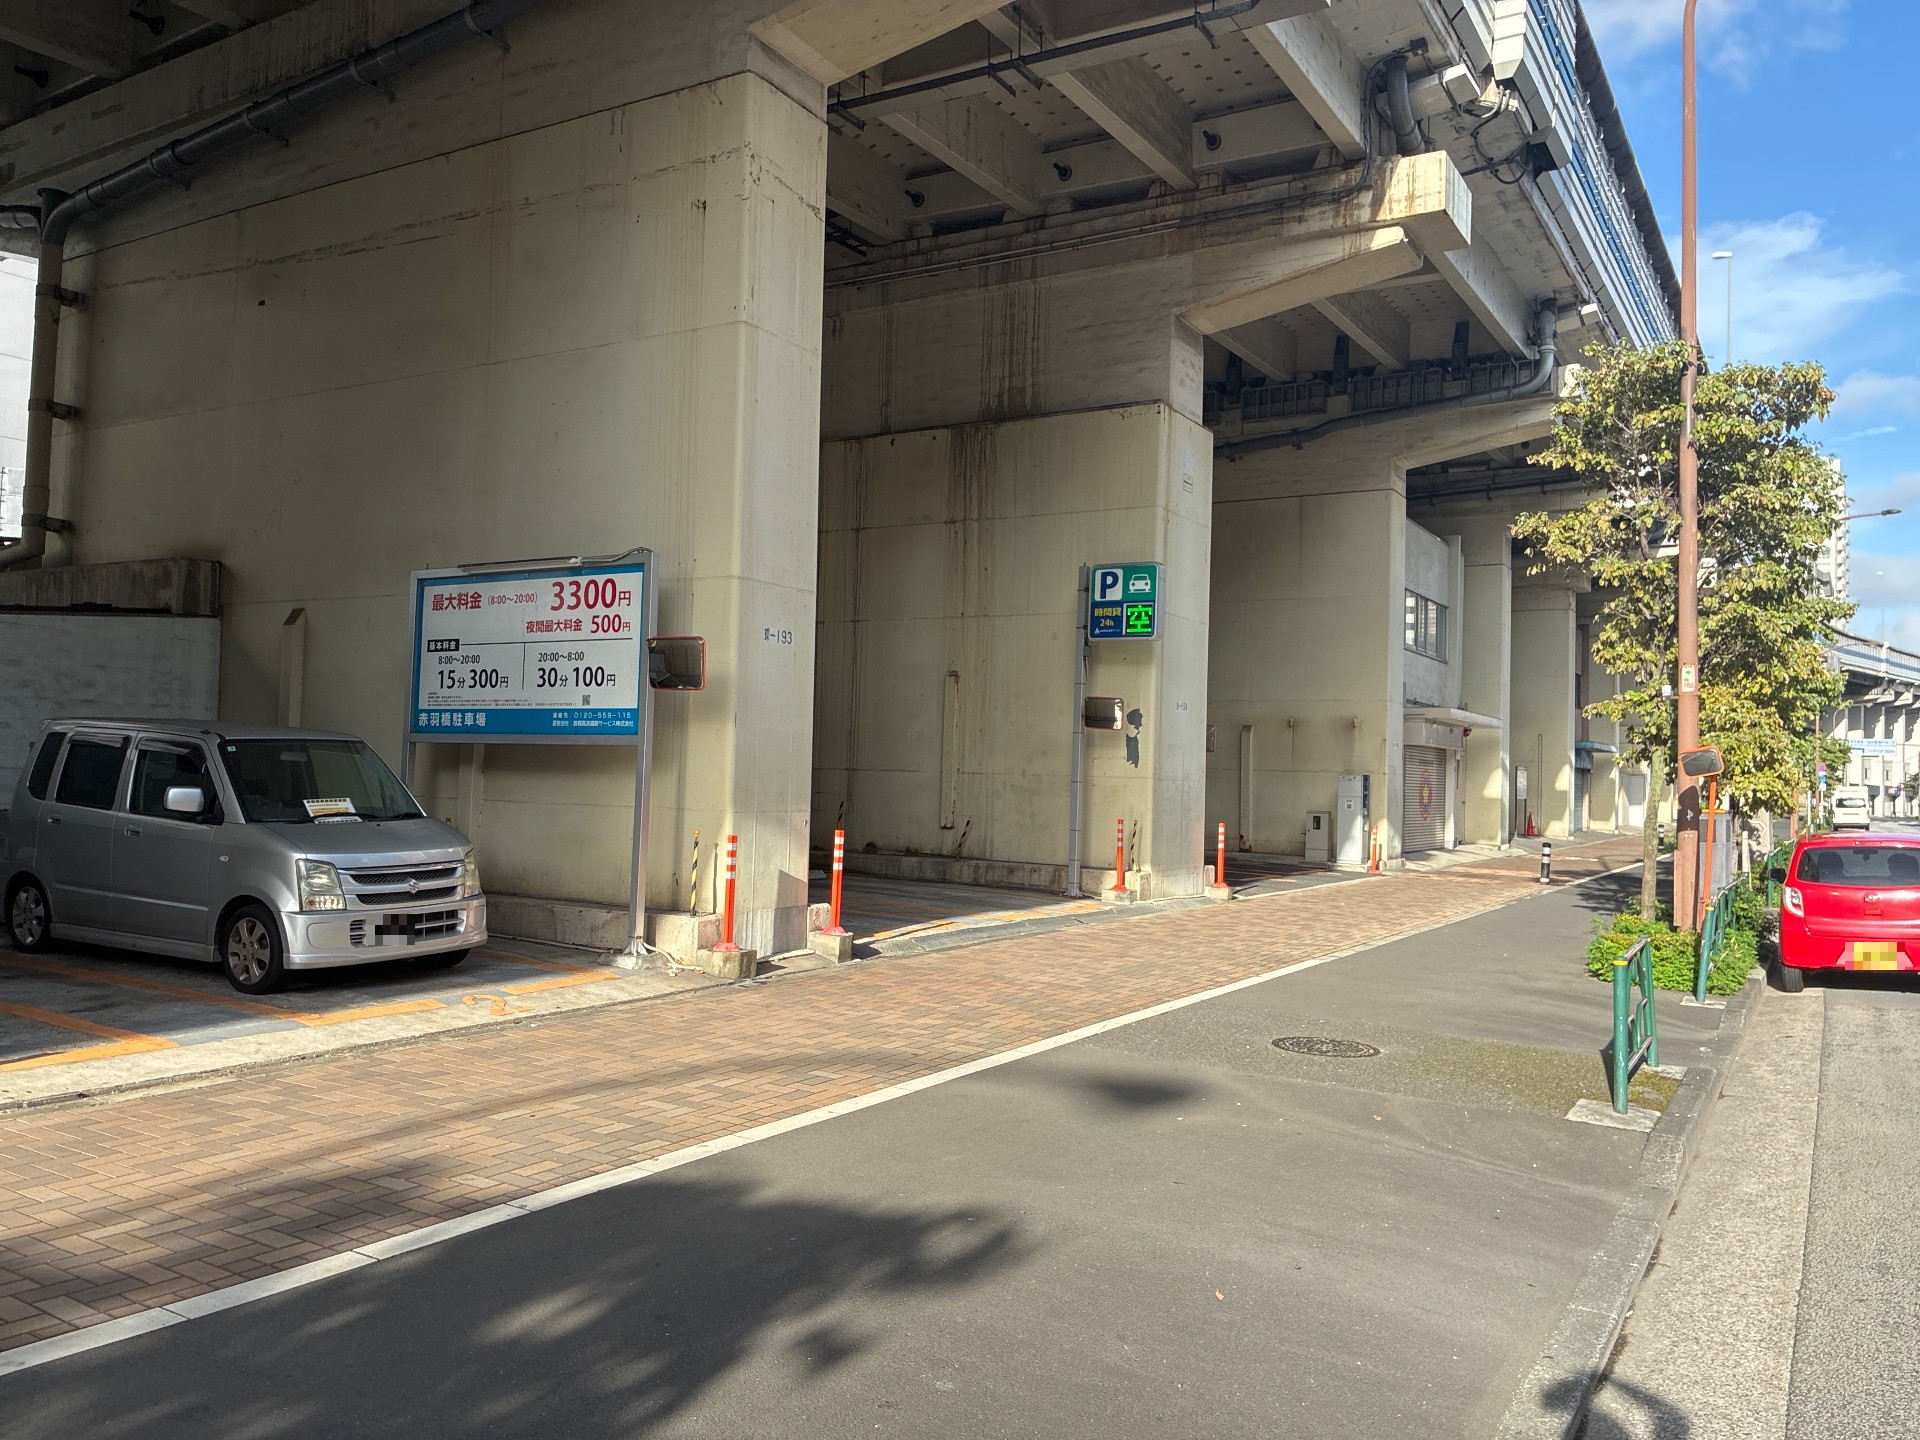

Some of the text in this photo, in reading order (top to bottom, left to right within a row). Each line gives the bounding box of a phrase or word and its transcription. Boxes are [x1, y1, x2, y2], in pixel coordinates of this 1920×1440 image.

[432, 591, 482, 611] 最大料金
[550, 578, 631, 611] 3300円
[1100, 571, 1119, 599] P
[526, 614, 631, 634] 夜間最大料金 500円
[1100, 619, 1114, 627] 24h
[1127, 604, 1152, 633] 空
[418, 712, 486, 727] 赤羽橋駐車場
